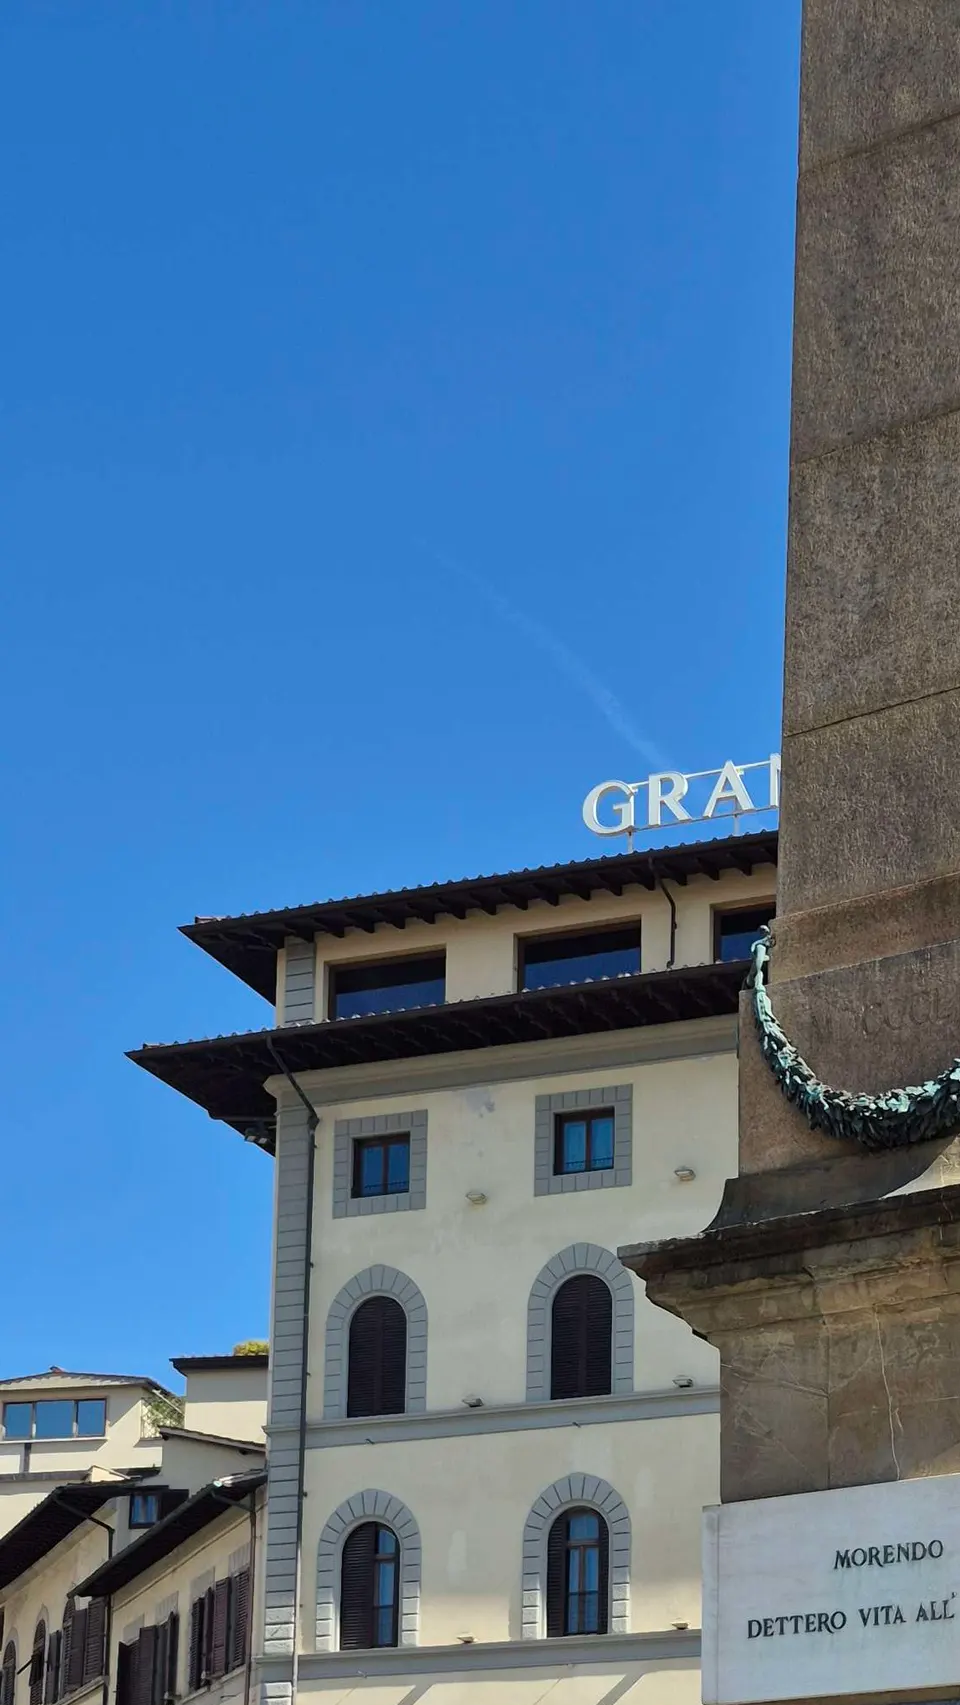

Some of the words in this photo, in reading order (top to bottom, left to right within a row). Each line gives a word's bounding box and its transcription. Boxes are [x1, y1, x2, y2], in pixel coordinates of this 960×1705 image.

[583, 752, 782, 836] GRA
[834, 1539, 944, 1570] MORENDO
[747, 1610, 847, 1640] DETTERO
[858, 1605, 907, 1628] VITA
